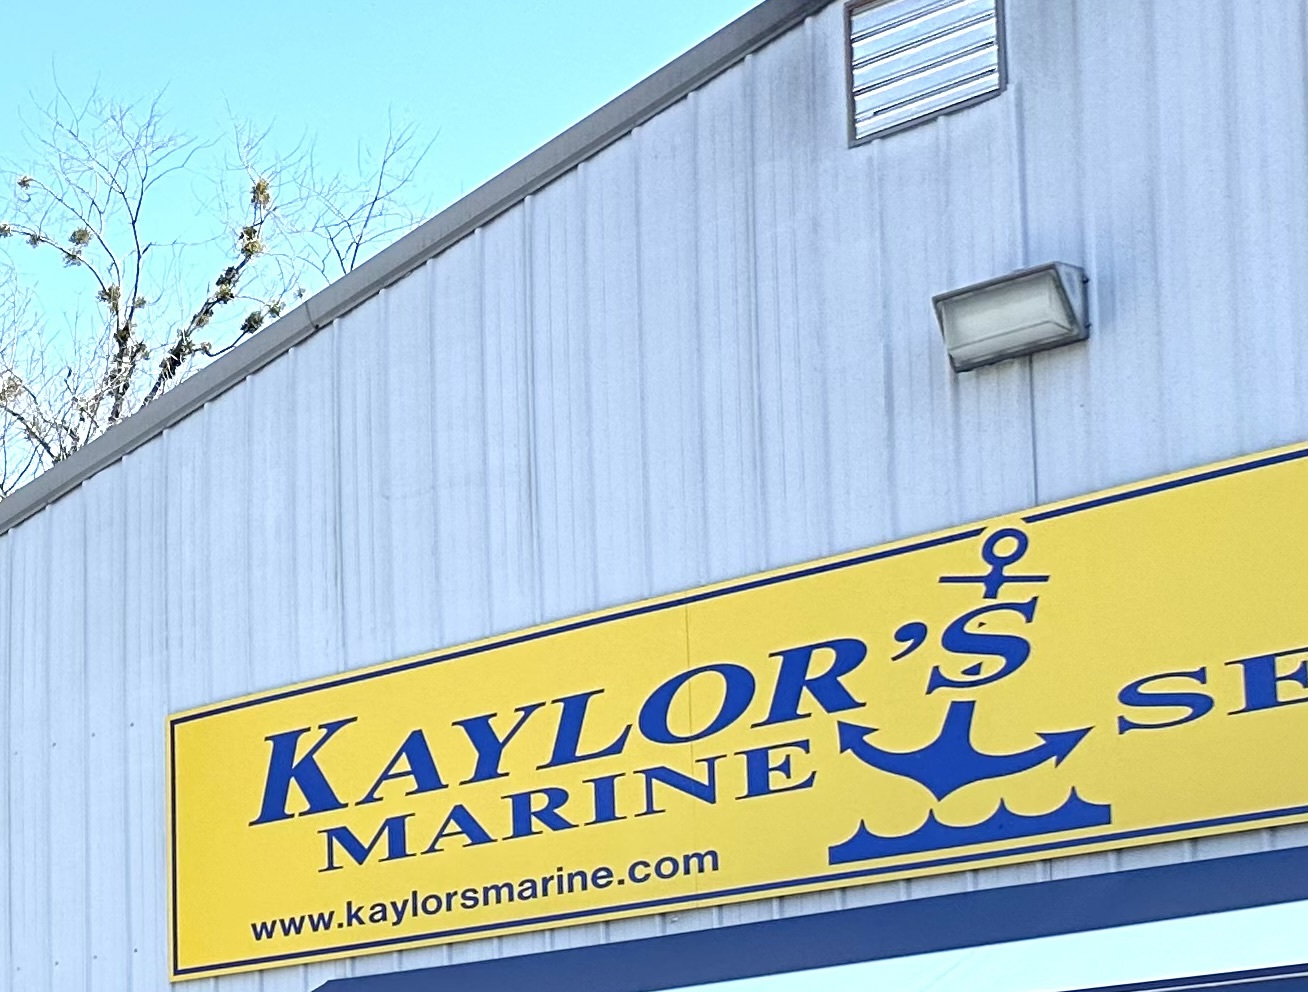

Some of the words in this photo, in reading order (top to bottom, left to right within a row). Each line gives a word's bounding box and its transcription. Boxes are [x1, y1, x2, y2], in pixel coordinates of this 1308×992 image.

[248, 597, 1039, 827] KAYLOR'S
[318, 738, 817, 873] MARINE
[250, 849, 720, 942] www.kaylorsmarine.com
